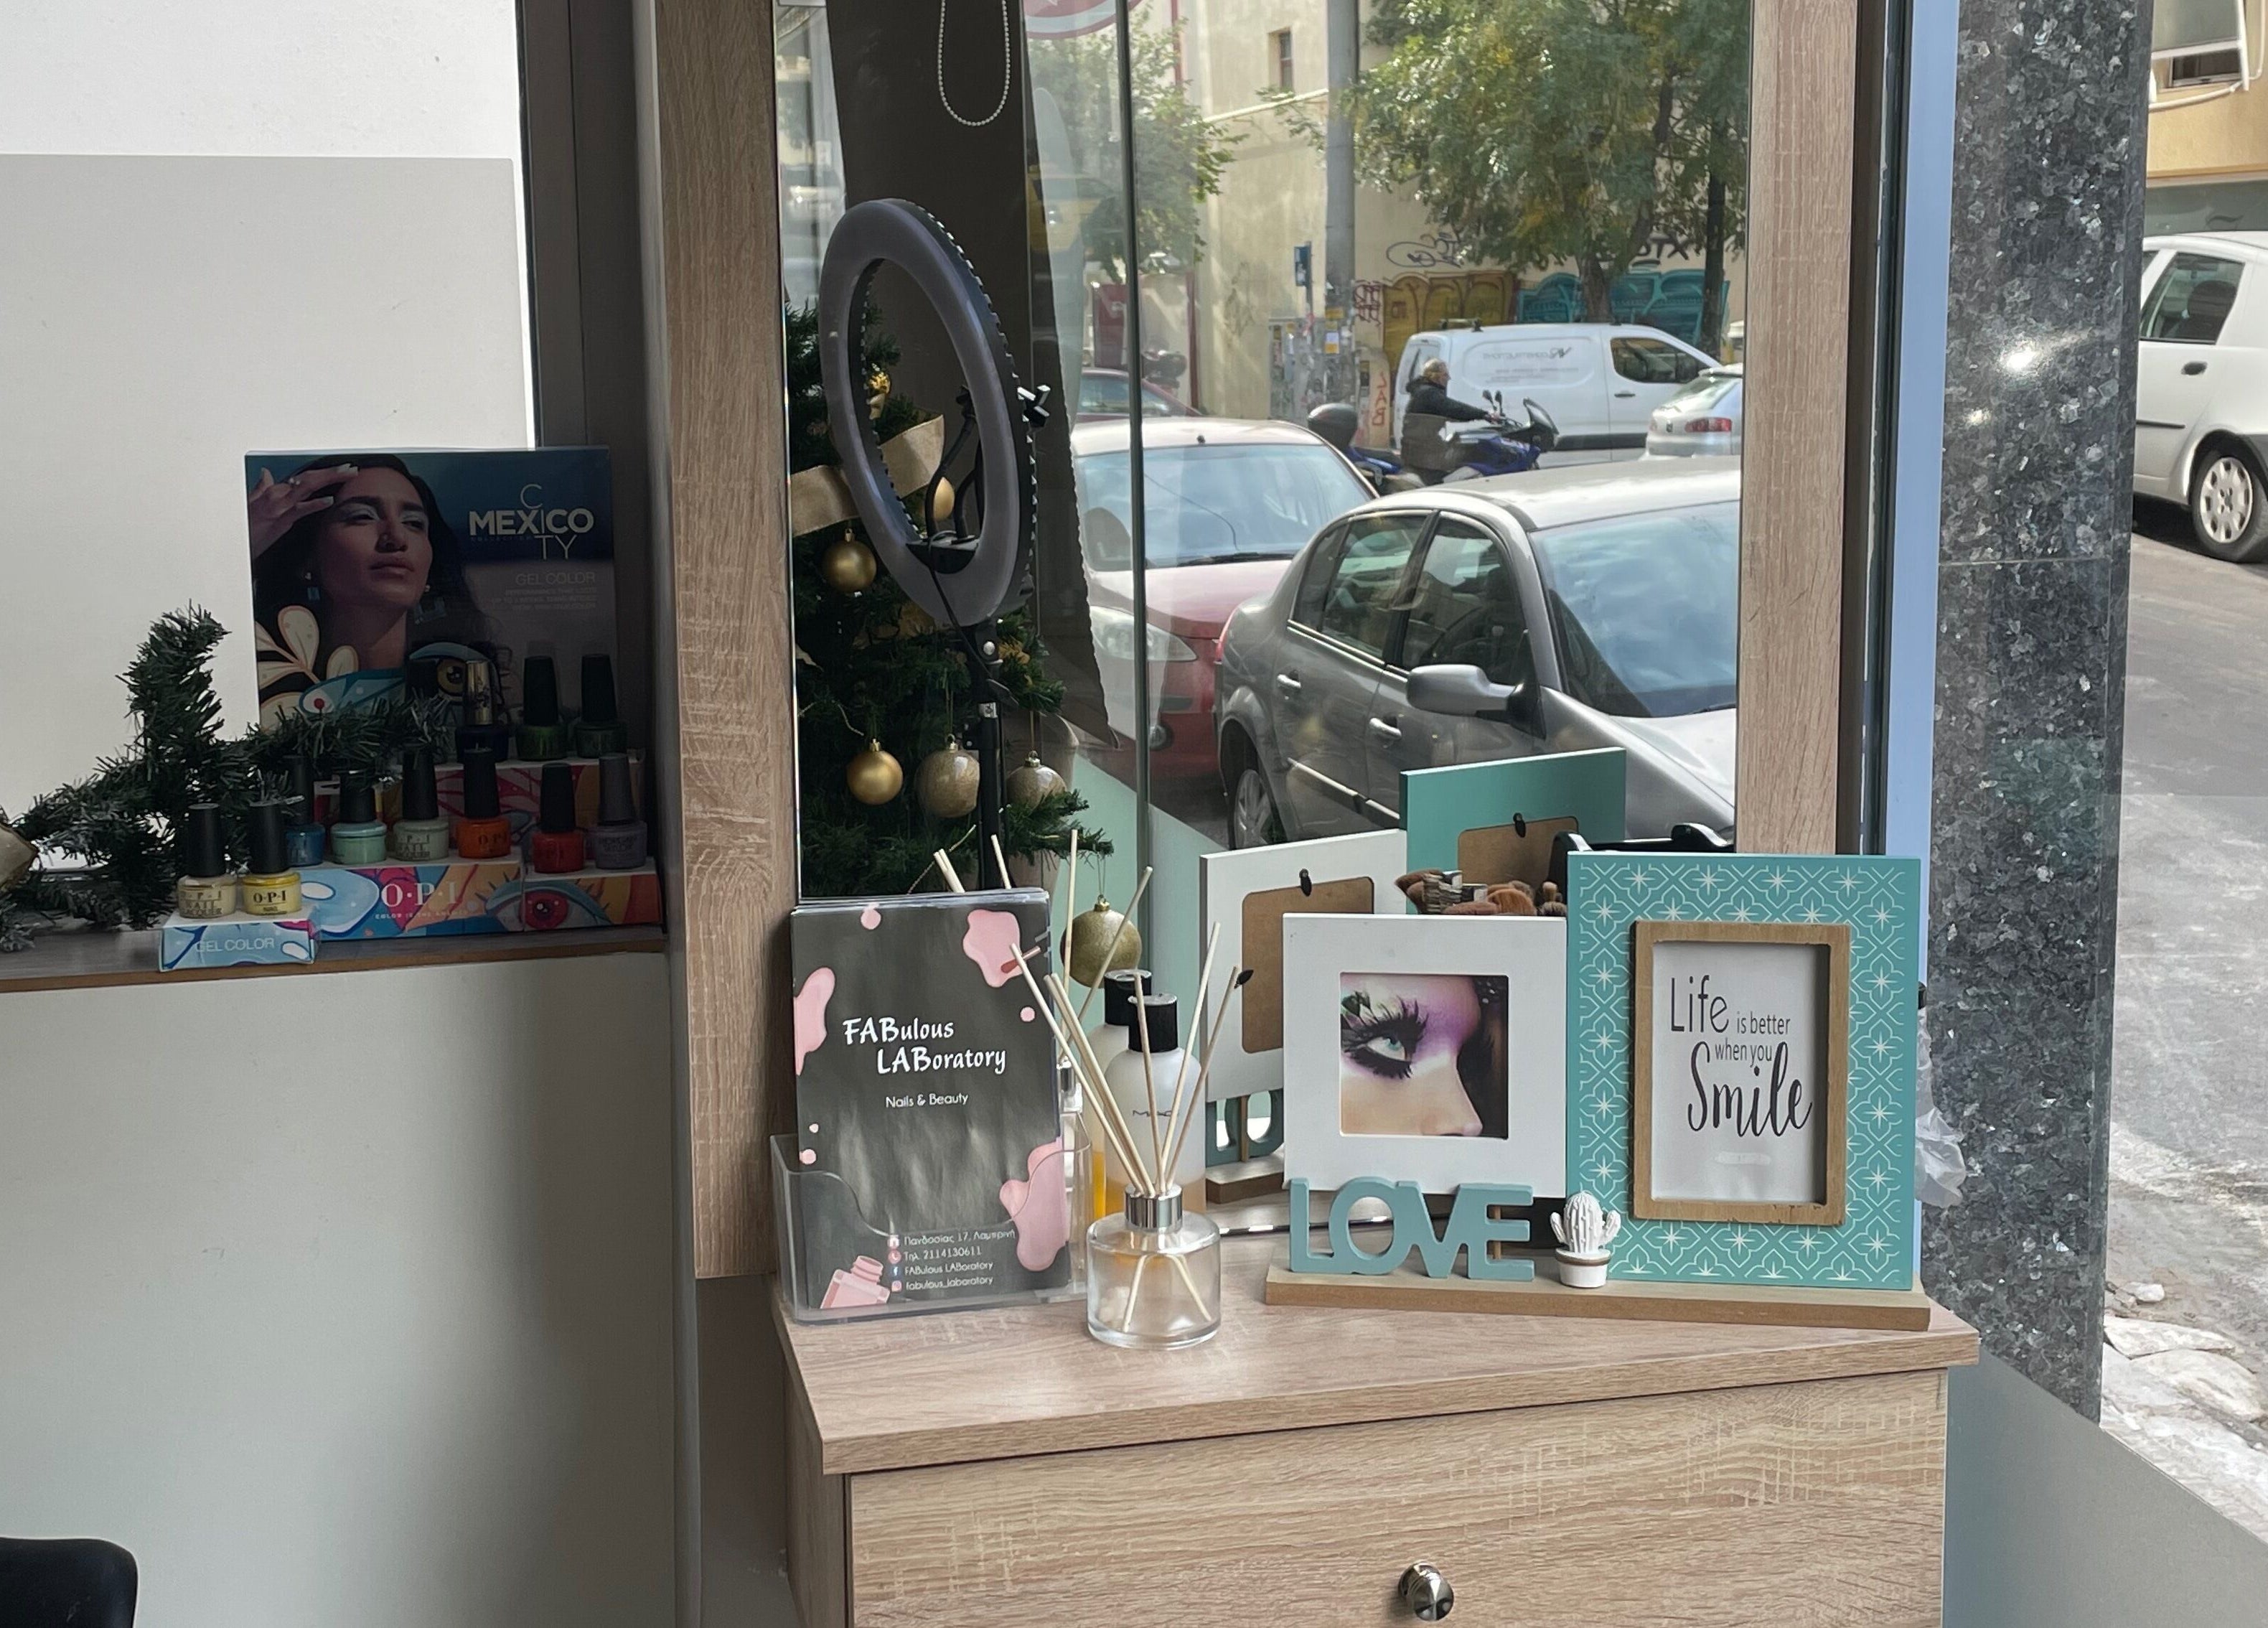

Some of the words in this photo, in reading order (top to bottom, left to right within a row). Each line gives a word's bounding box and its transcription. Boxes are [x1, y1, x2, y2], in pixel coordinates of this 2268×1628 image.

[469, 508, 594, 535] MEXICO
[515, 574, 542, 586] GEL
[545, 571, 596, 585] COLOR
[195, 940, 223, 953] GEL
[225, 937, 275, 951] COLOR
[1670, 974, 1730, 1034] Life
[1737, 1011, 1748, 1035] is
[1749, 1010, 1791, 1036] better
[842, 1016, 955, 1046] FABulous
[876, 1045, 1007, 1076] LABoratory
[1714, 1037, 1748, 1062] when
[1749, 1043, 1773, 1069] you
[885, 1095, 914, 1109] Nails
[917, 1093, 926, 1107] &
[929, 1092, 969, 1106] Beauty
[1687, 1040, 1814, 1138] Smile
[1289, 1176, 1535, 1282] LOVE
[923, 1245, 982, 1260] 2114130611
[904, 1264, 944, 1276] FABulous
[945, 1260, 994, 1273] LABoratory
